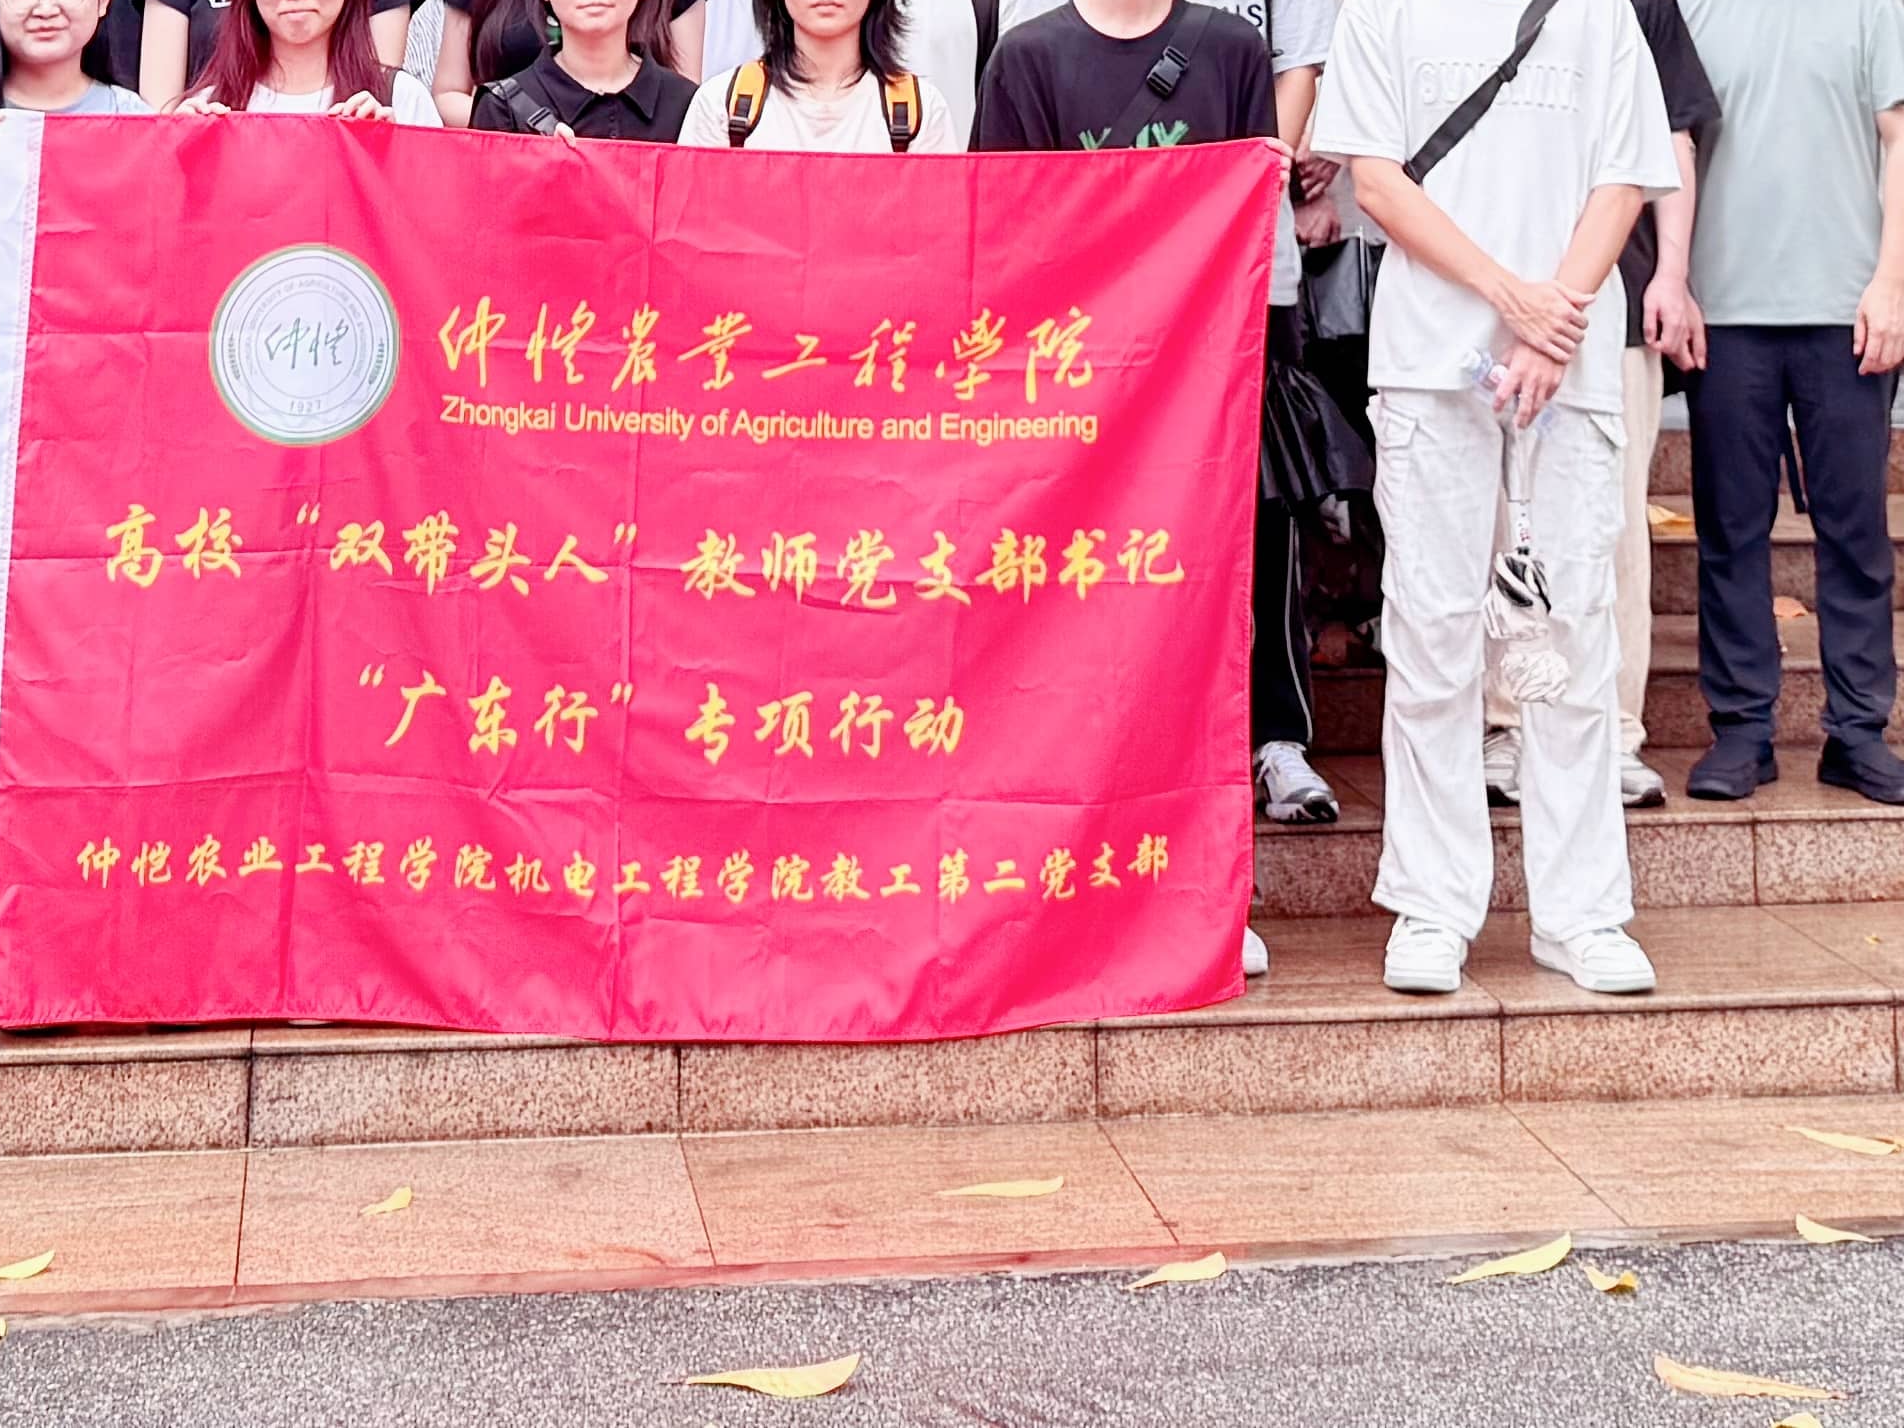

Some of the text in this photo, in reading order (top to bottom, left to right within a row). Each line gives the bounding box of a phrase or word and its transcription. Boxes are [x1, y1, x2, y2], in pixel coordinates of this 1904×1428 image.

[441, 396, 1098, 444] Zhongkai University of Agriculture and Engineering
[105, 501, 1186, 608] 高校 “双带头人” 教师党支部书记
[358, 663, 965, 766] “广东行” 专项行动
[75, 832, 1170, 905] 仲恺农业工程学院机电工程学院教工第二党支部
